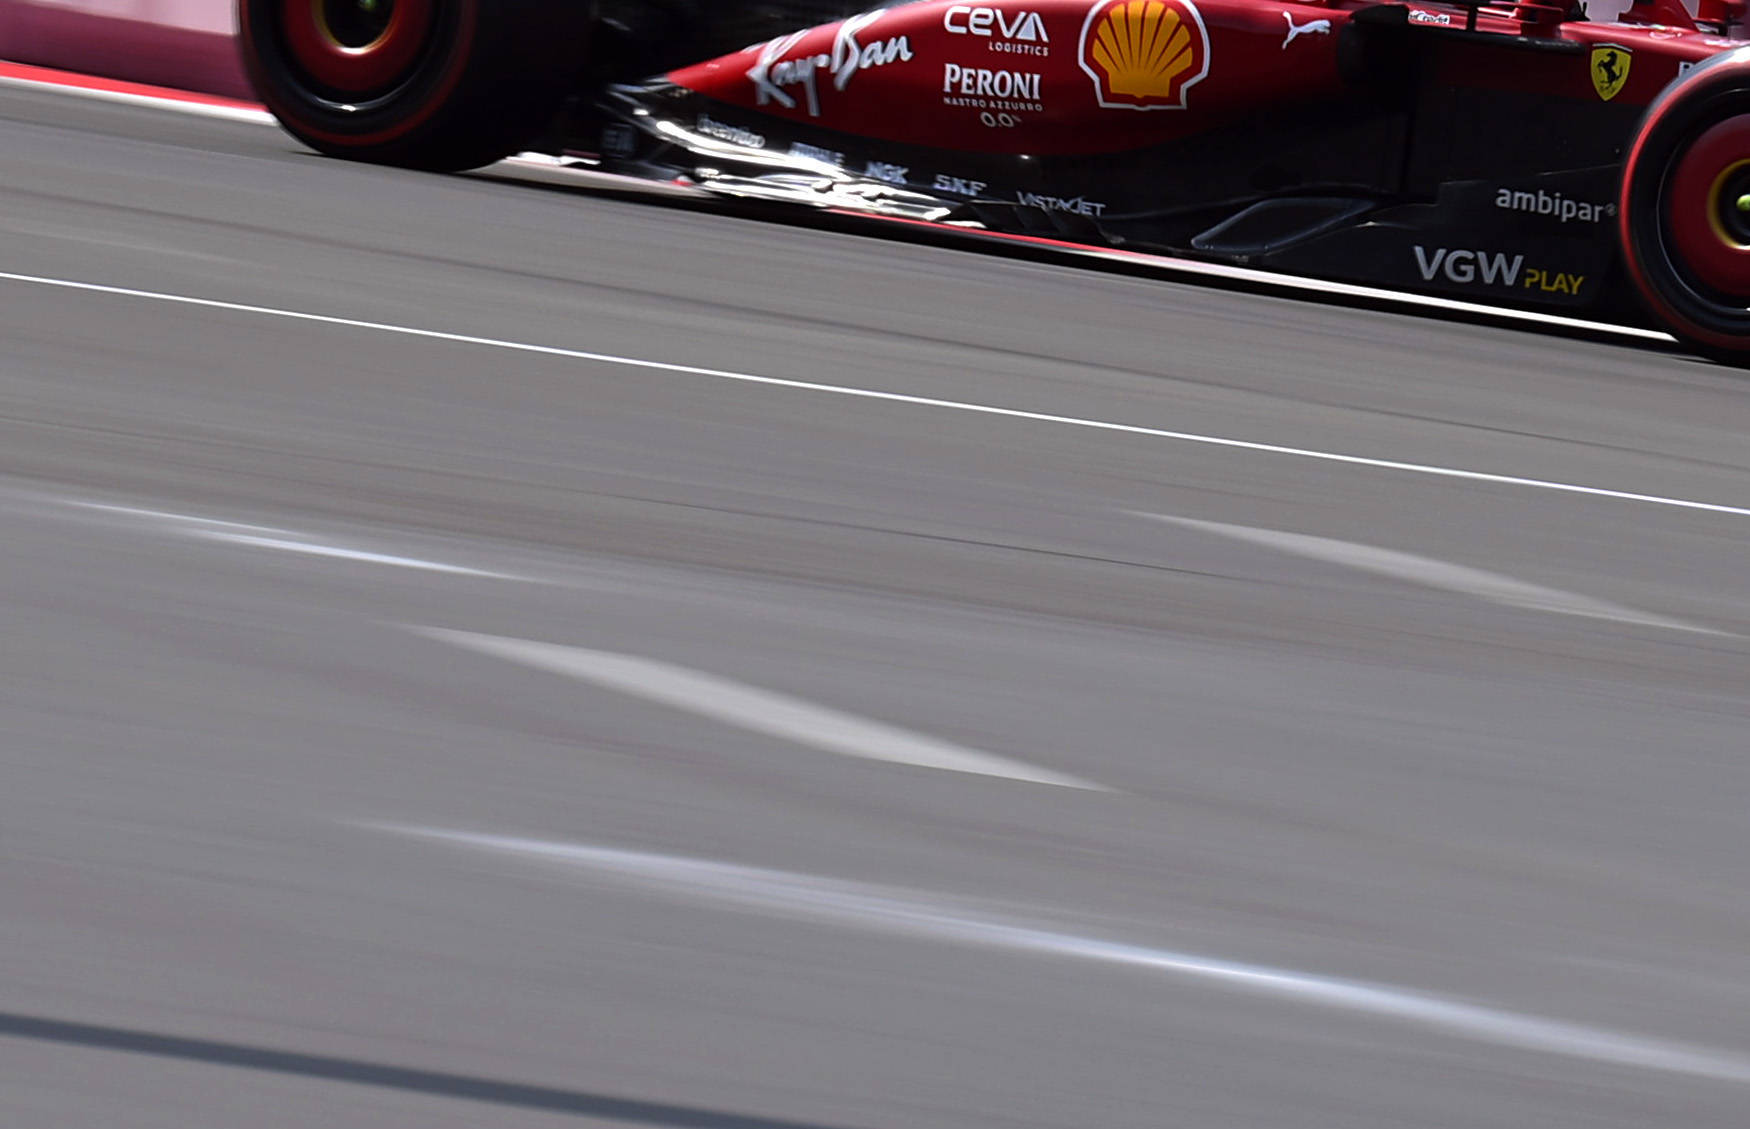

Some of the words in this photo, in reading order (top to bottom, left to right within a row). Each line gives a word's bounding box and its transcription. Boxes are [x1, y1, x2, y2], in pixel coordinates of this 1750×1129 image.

[742, 9, 913, 117] Ray-Ban
[988, 41, 1049, 57] LOGISTICS
[943, 63, 1041, 100] PERONI
[943, 97, 987, 109] NASTRO
[989, 100, 1043, 112] AZZURRO
[933, 175, 987, 197] SKF
[1414, 245, 1524, 287] VGW
[1524, 269, 1586, 296] PLAY
